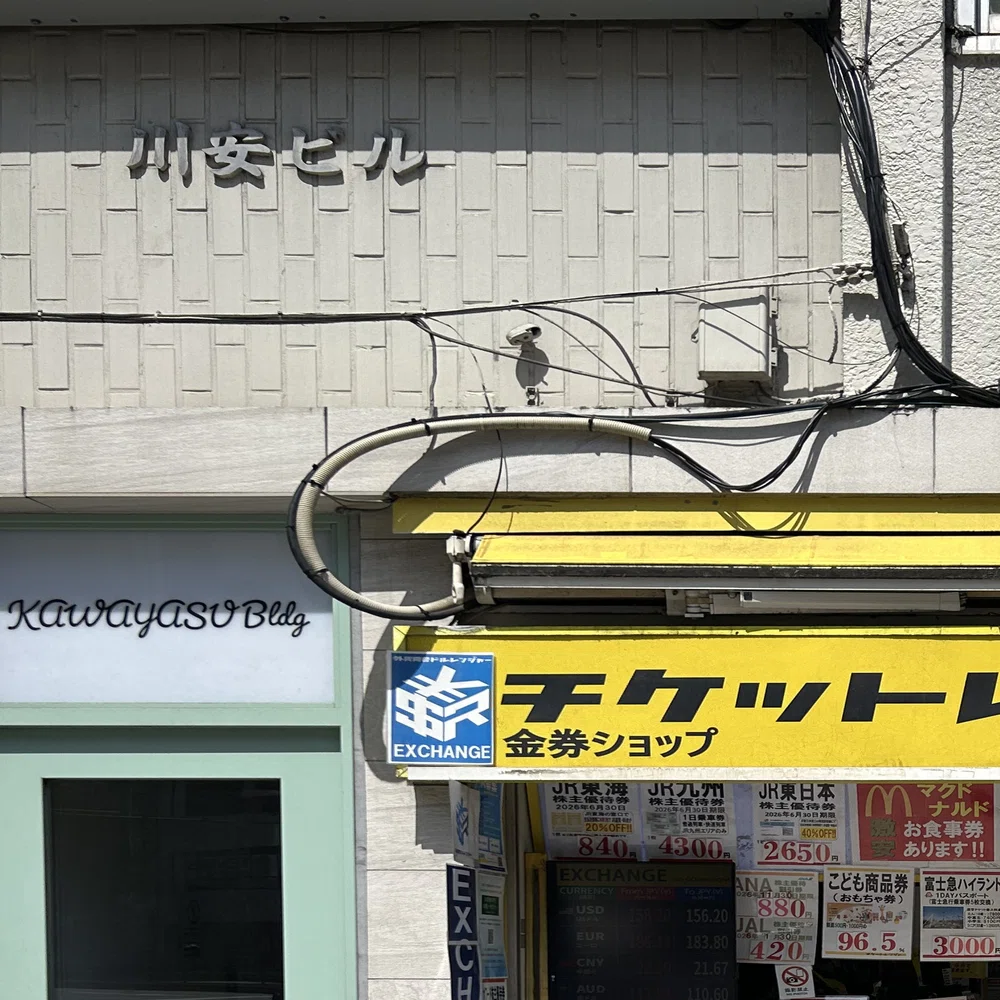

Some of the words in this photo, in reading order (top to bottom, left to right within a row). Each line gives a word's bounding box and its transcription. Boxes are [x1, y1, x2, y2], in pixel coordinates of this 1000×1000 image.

[242, 600, 310, 638] Bldg
[503, 727, 718, 758] 金券ショップ
[393, 743, 491, 759] EXCHANGE
[552, 783, 628, 796] JR東海
[648, 783, 724, 798] JR九州
[759, 783, 835, 801] JR東日本
[552, 795, 630, 804] 株主優待券
[649, 797, 724, 806] 株主優待券
[759, 801, 836, 810] 株主優待券
[928, 801, 990, 817] ナルド
[585, 823, 632, 833] 20%OFF!!
[903, 820, 984, 838] お食事券
[559, 868, 667, 882] EXCHANGE
[829, 873, 908, 893] こども商品券
[559, 887, 615, 895] CURRENCY
[576, 906, 604, 915] USD
[576, 932, 605, 941] EUR
[576, 958, 604, 967] CNY
[576, 985, 606, 993] AUD
